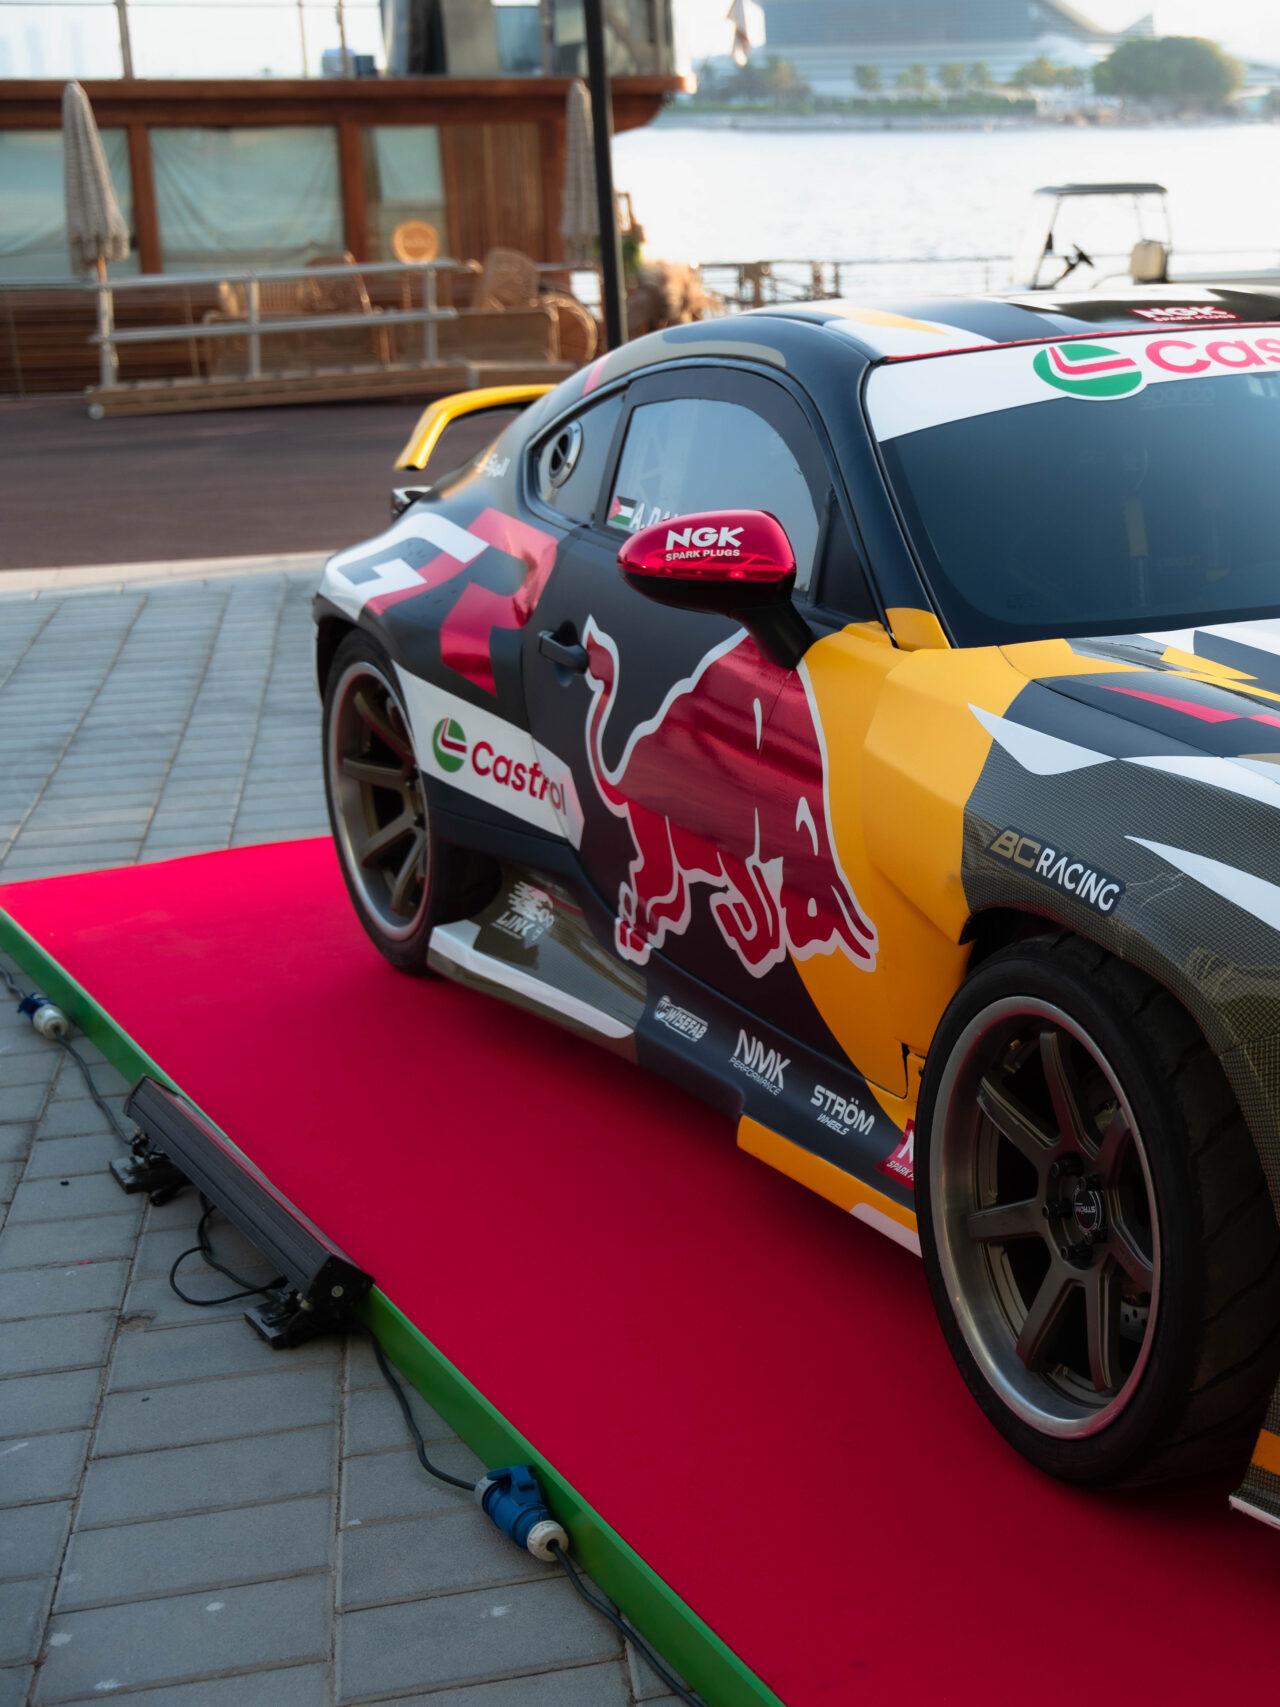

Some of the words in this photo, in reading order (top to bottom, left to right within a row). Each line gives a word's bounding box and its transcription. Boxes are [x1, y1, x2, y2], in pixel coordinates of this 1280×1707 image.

[1132, 306, 1228, 318] NGK
[665, 526, 745, 551] NGK
[665, 550, 700, 562] SPARK
[703, 549, 740, 558] PLUGS
[471, 740, 566, 815] Castrol
[733, 1028, 791, 1089] NMK
[728, 1056, 782, 1096] PERFORMANCE
[810, 1084, 876, 1136] STRÖM
[816, 1113, 850, 1136] WHEELS
